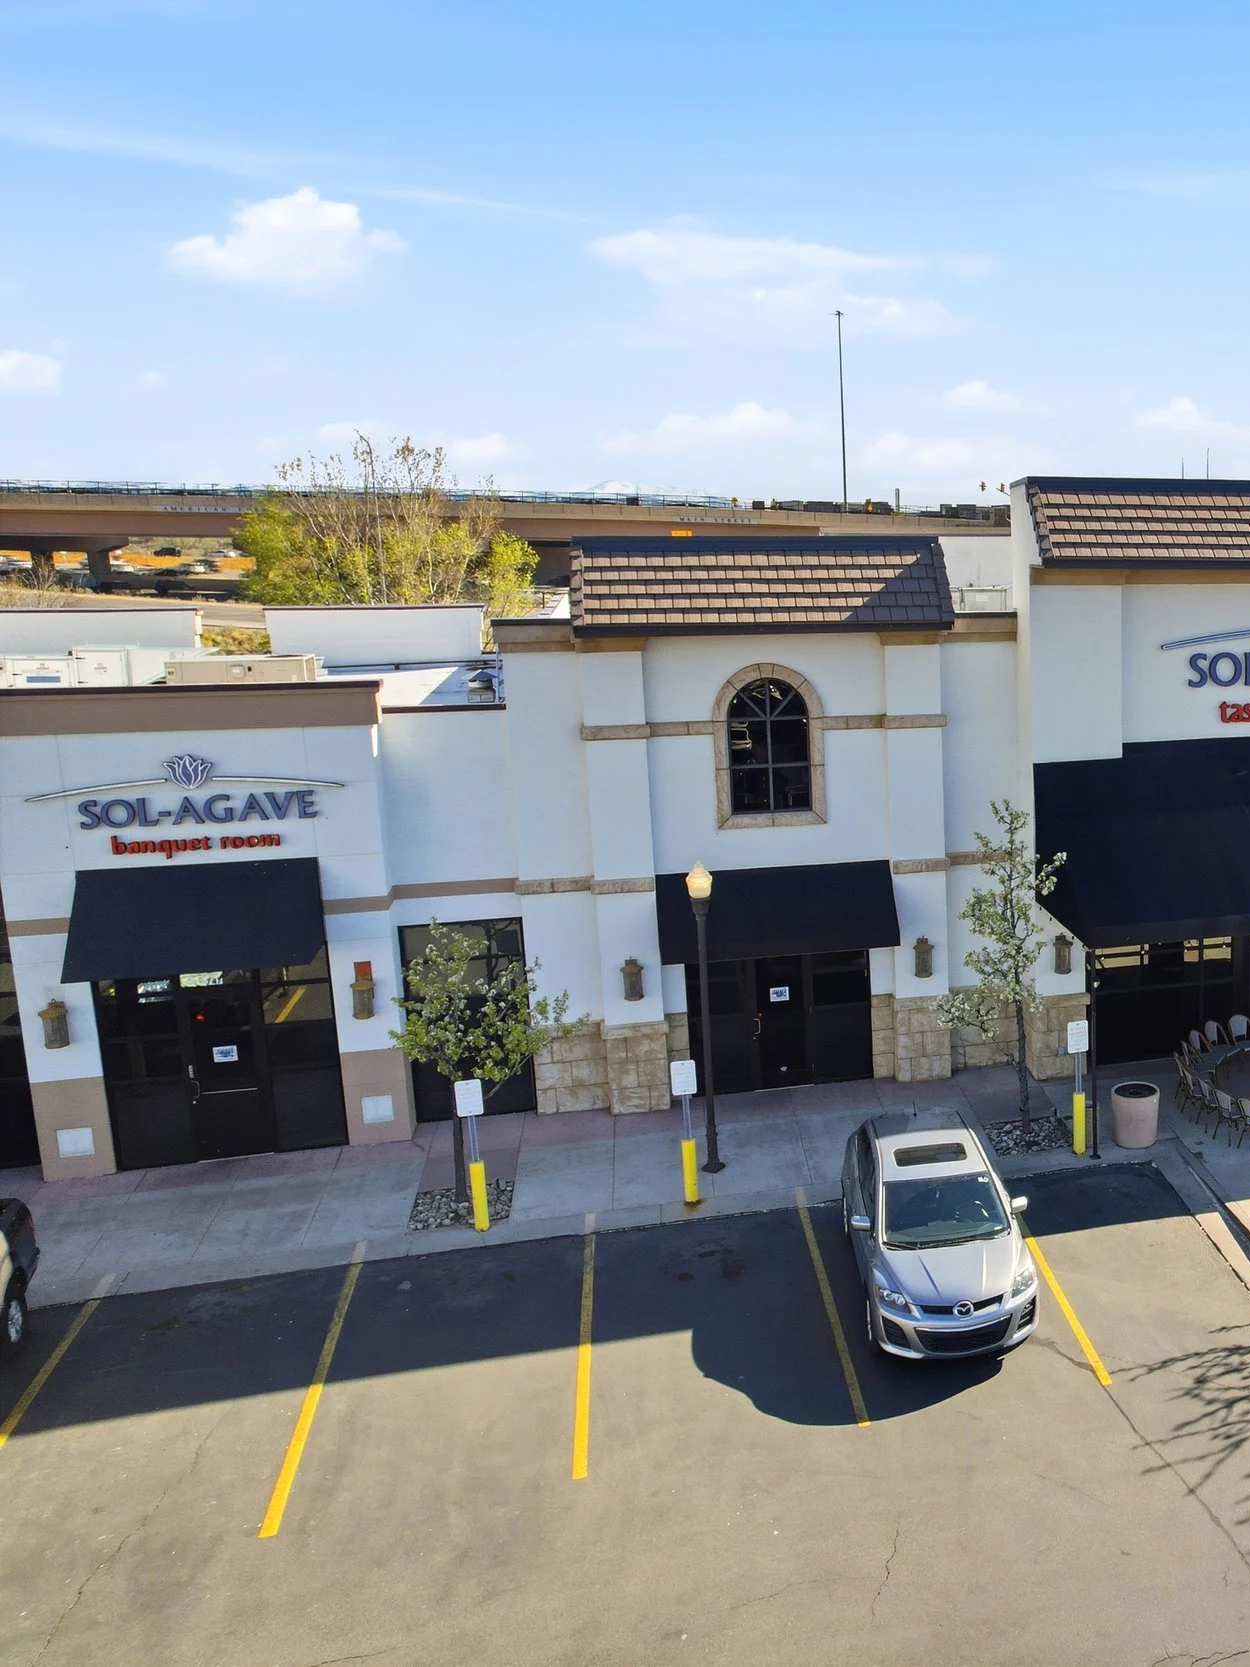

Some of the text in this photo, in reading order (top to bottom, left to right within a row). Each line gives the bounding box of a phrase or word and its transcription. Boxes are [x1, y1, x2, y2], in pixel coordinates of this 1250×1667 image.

[77, 790, 319, 830] SOL-AGAVE
[110, 832, 281, 859] banquet room
